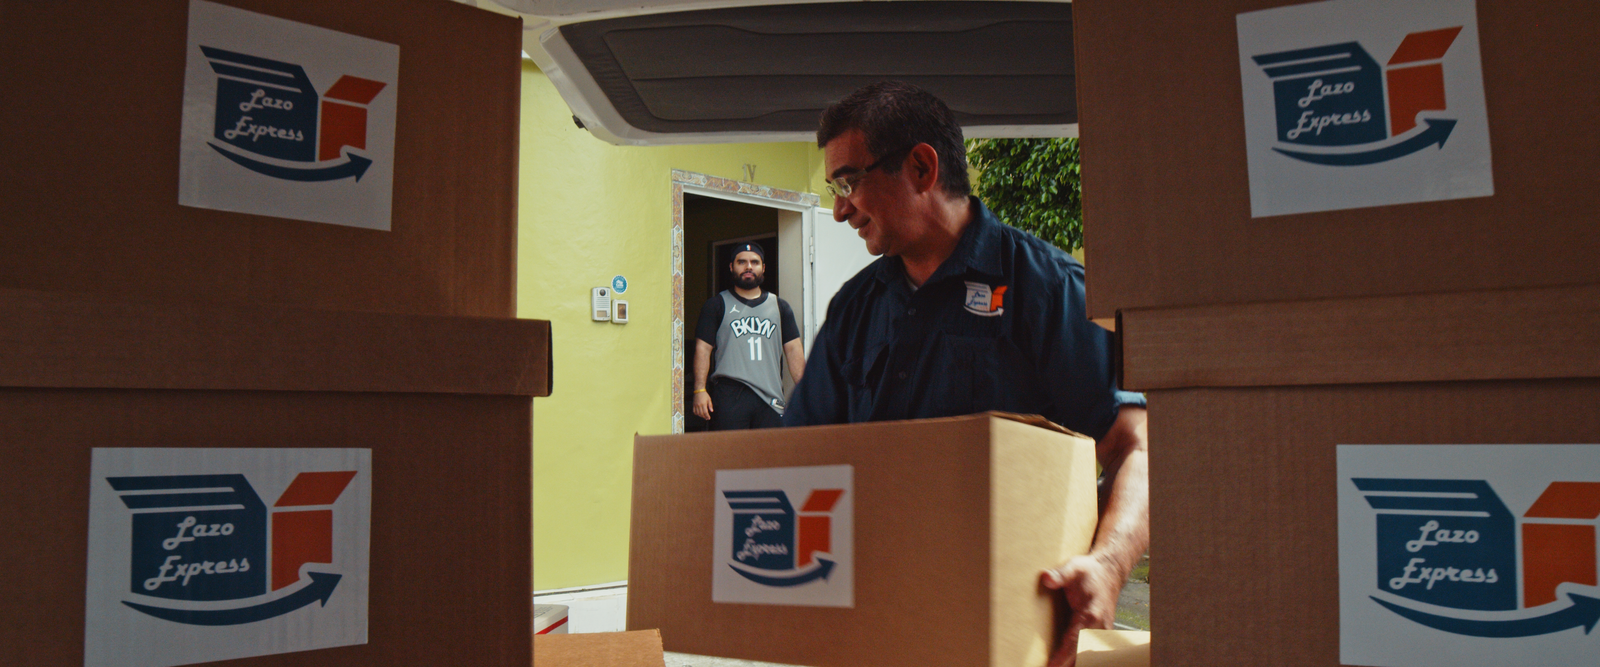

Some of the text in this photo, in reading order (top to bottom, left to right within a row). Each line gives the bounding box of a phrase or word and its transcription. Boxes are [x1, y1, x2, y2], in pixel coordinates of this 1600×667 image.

[239, 88, 294, 112] Lazo
[1297, 79, 1355, 108] Lazo
[223, 115, 305, 142] Express
[1286, 109, 1372, 140] Express
[729, 315, 777, 339] BKLYN
[747, 336, 762, 361] 11
[162, 515, 235, 551] Lazo
[1405, 520, 1480, 553] Lazo
[143, 555, 250, 591] Express
[1388, 557, 1499, 591] Express
